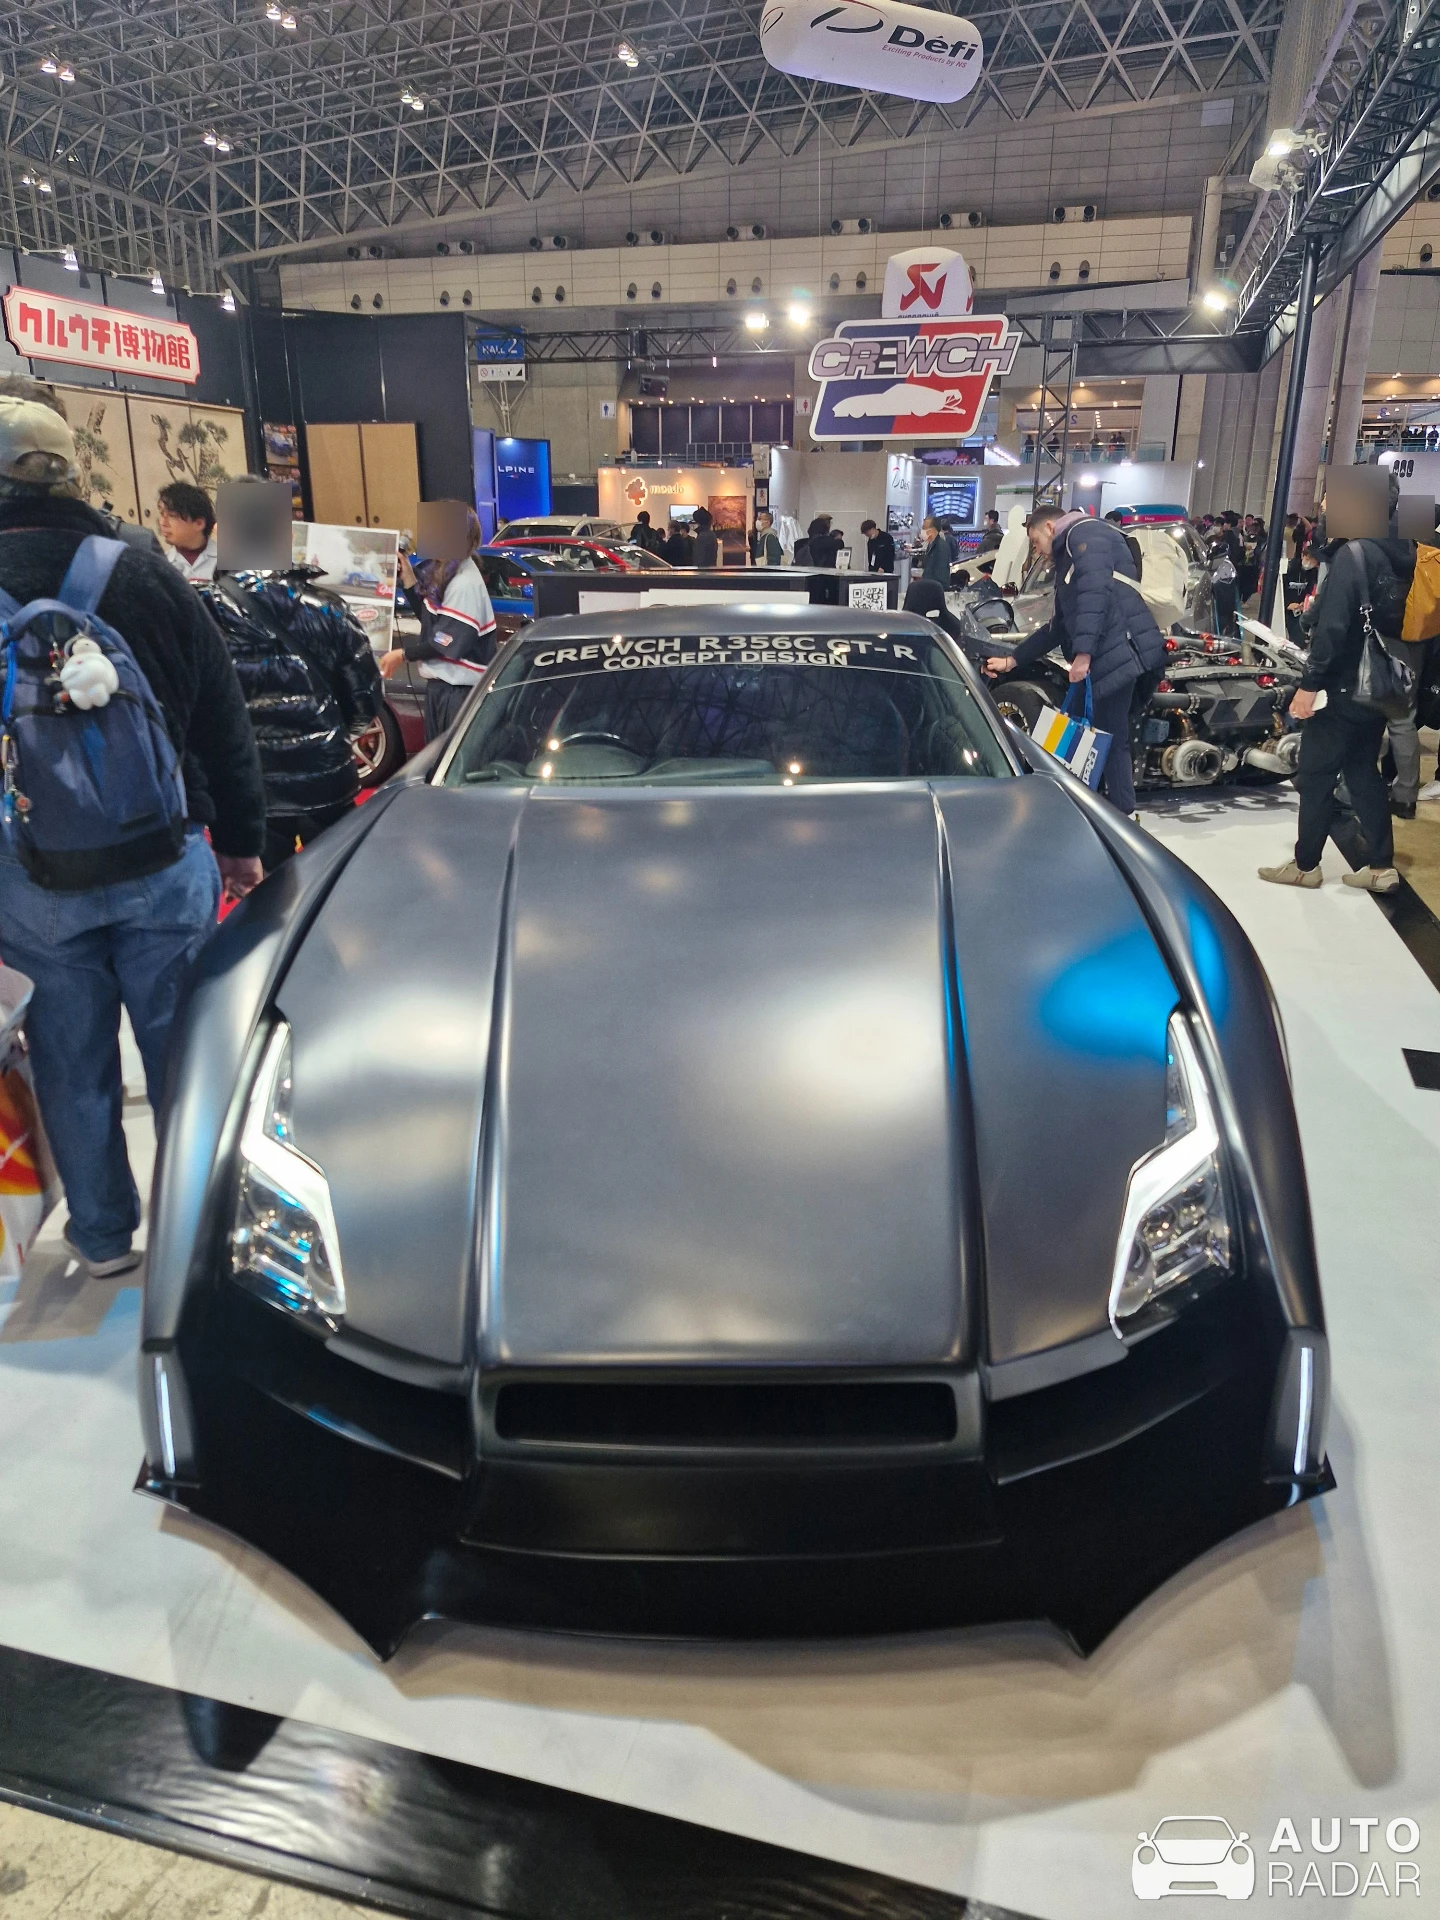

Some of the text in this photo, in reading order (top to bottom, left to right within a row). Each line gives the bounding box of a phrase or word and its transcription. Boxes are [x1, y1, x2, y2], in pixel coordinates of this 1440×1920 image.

[882, 44, 912, 57] Exciting
[914, 51, 945, 64] Products
[945, 59, 955, 68] by
[19, 302, 191, 370] クルウチ博物館
[508, 338, 518, 354] 2
[811, 335, 1018, 378] CREWCH
[498, 465, 535, 474] LPINE
[533, 637, 681, 667] CREWCH
[826, 638, 918, 661] GT-R
[603, 650, 848, 670] CONCEPT DESIGN
